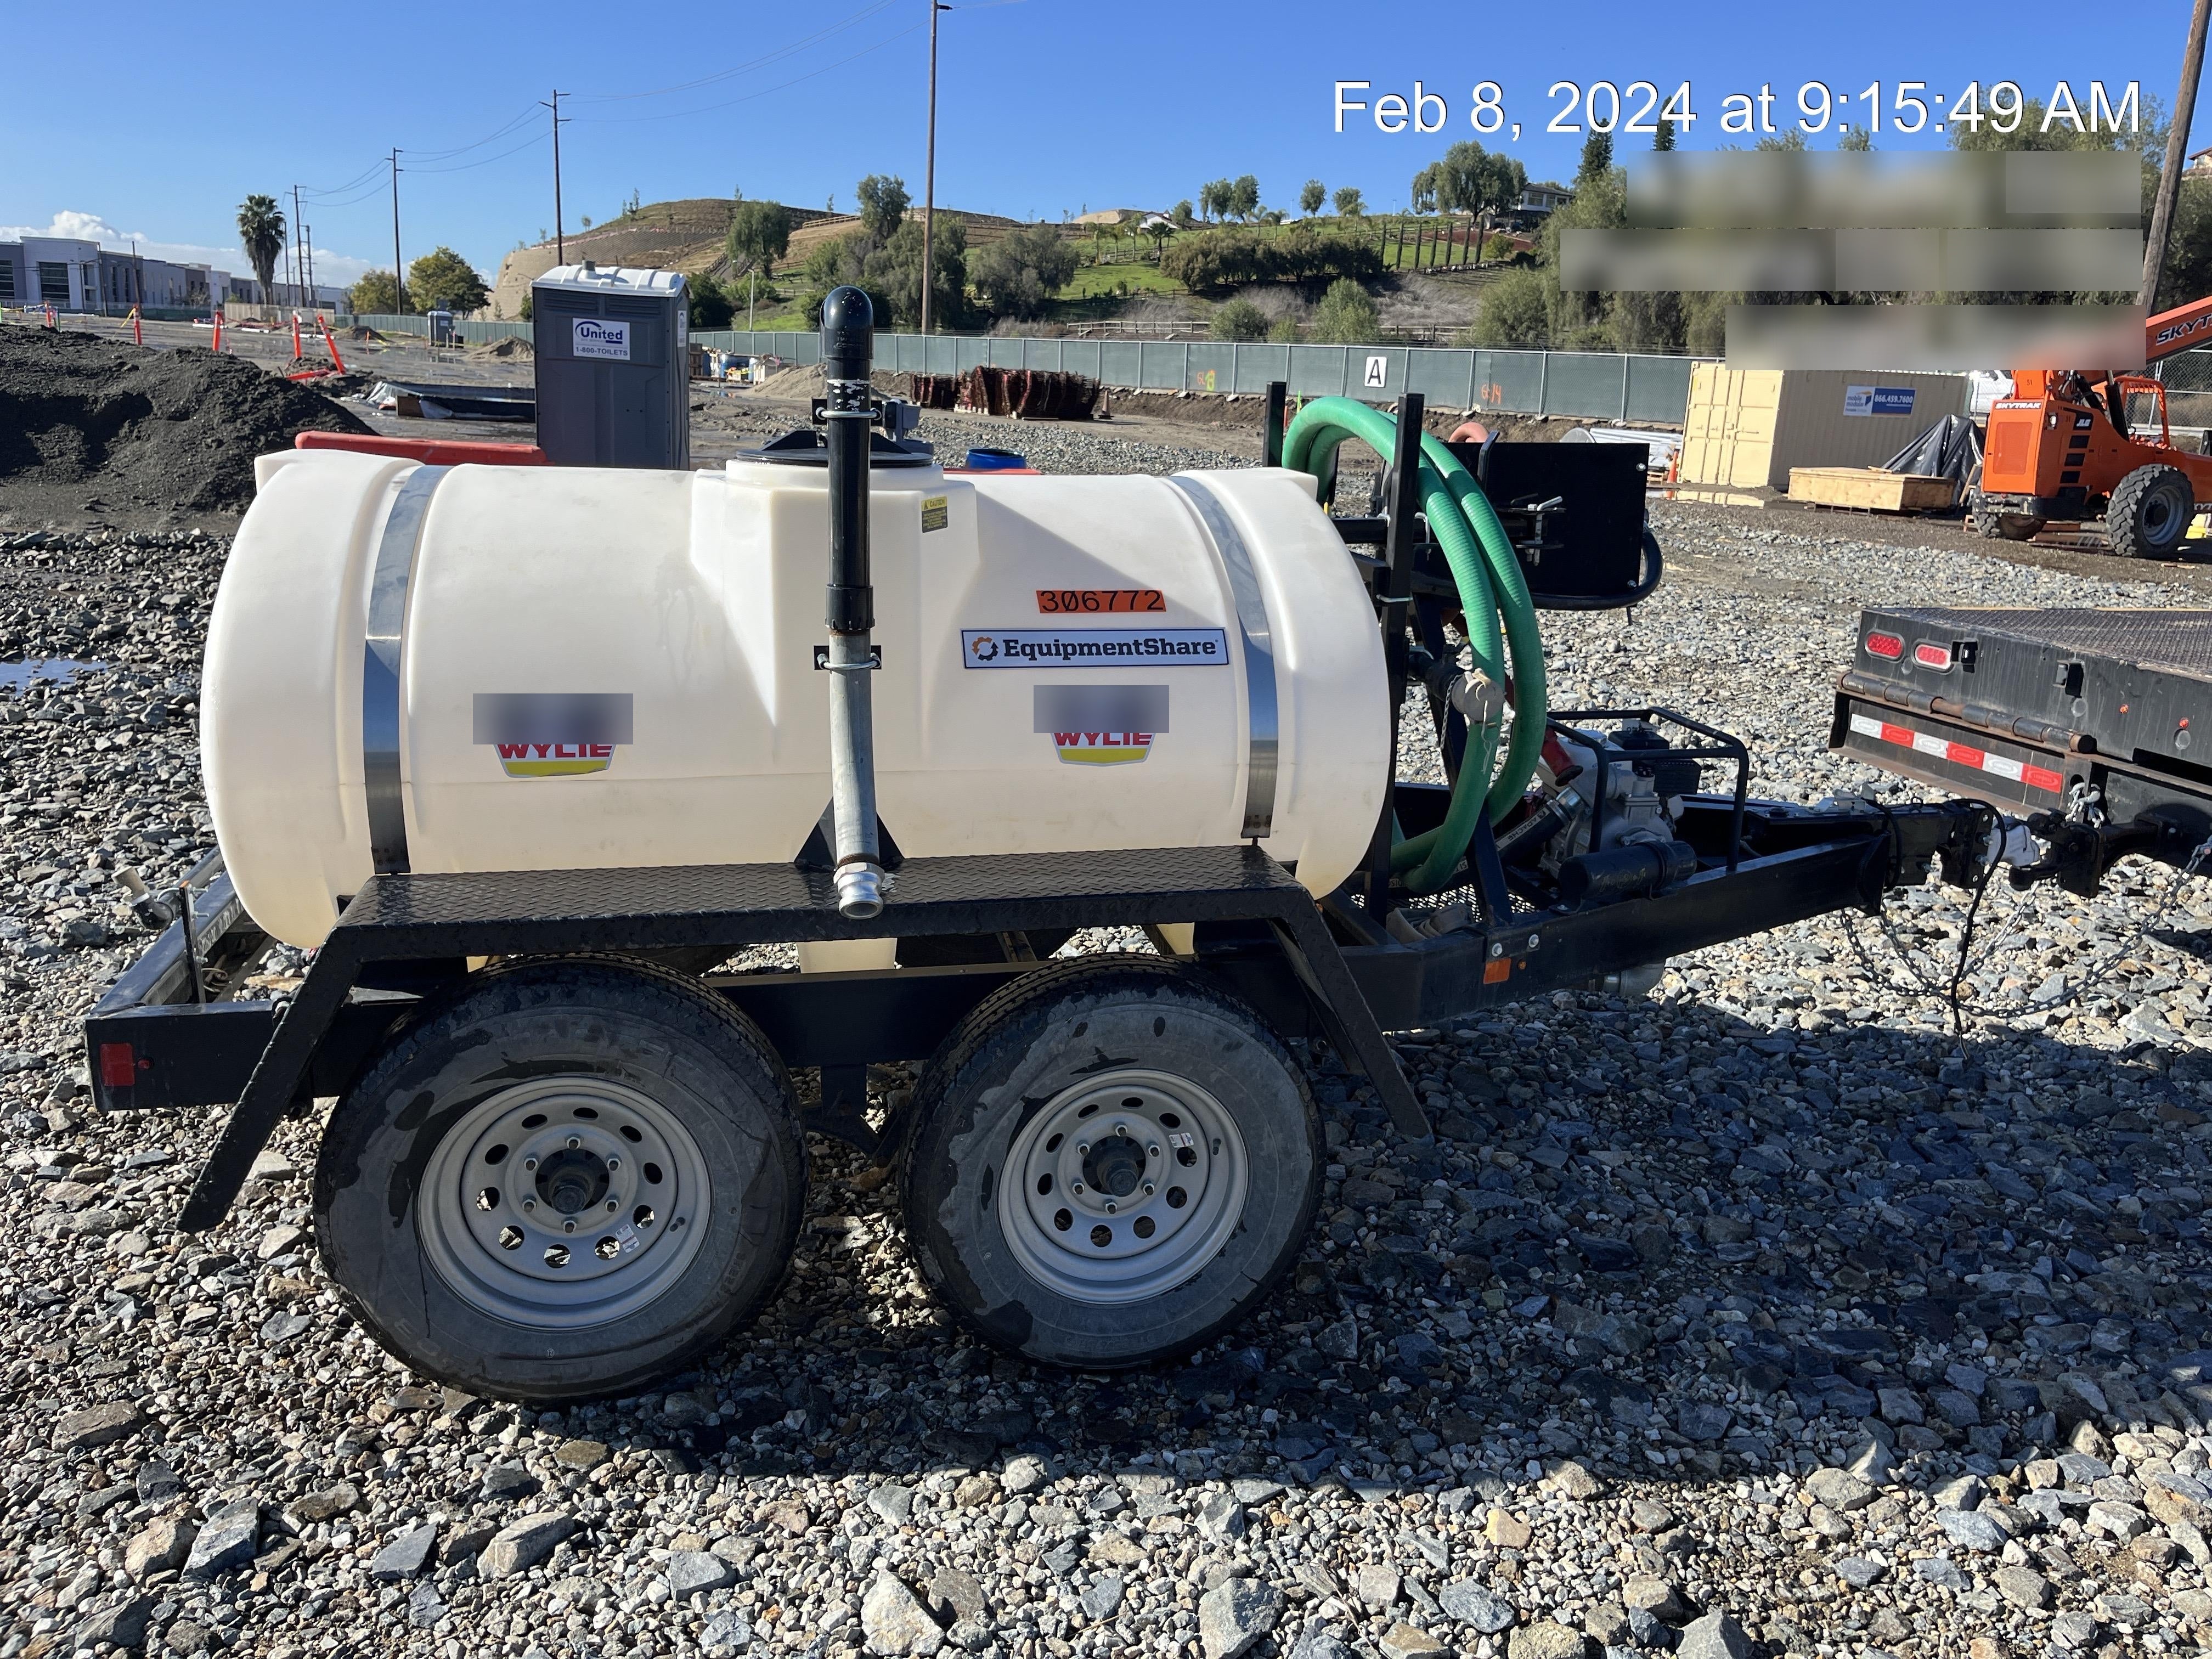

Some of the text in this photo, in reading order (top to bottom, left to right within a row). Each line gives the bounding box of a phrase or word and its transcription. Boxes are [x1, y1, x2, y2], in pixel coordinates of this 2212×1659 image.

[580, 326, 623, 340] United
[2155, 313, 2212, 346] SKYT
[576, 347, 628, 356] 1-800-TOILETS
[1367, 359, 1381, 385] A
[929, 499, 945, 507] CAUTION
[1041, 590, 1164, 612] 306772
[1003, 638, 1216, 661] EquipmentShare
[1053, 732, 1153, 746] WYLIE
[497, 744, 613, 759] WYLIE
